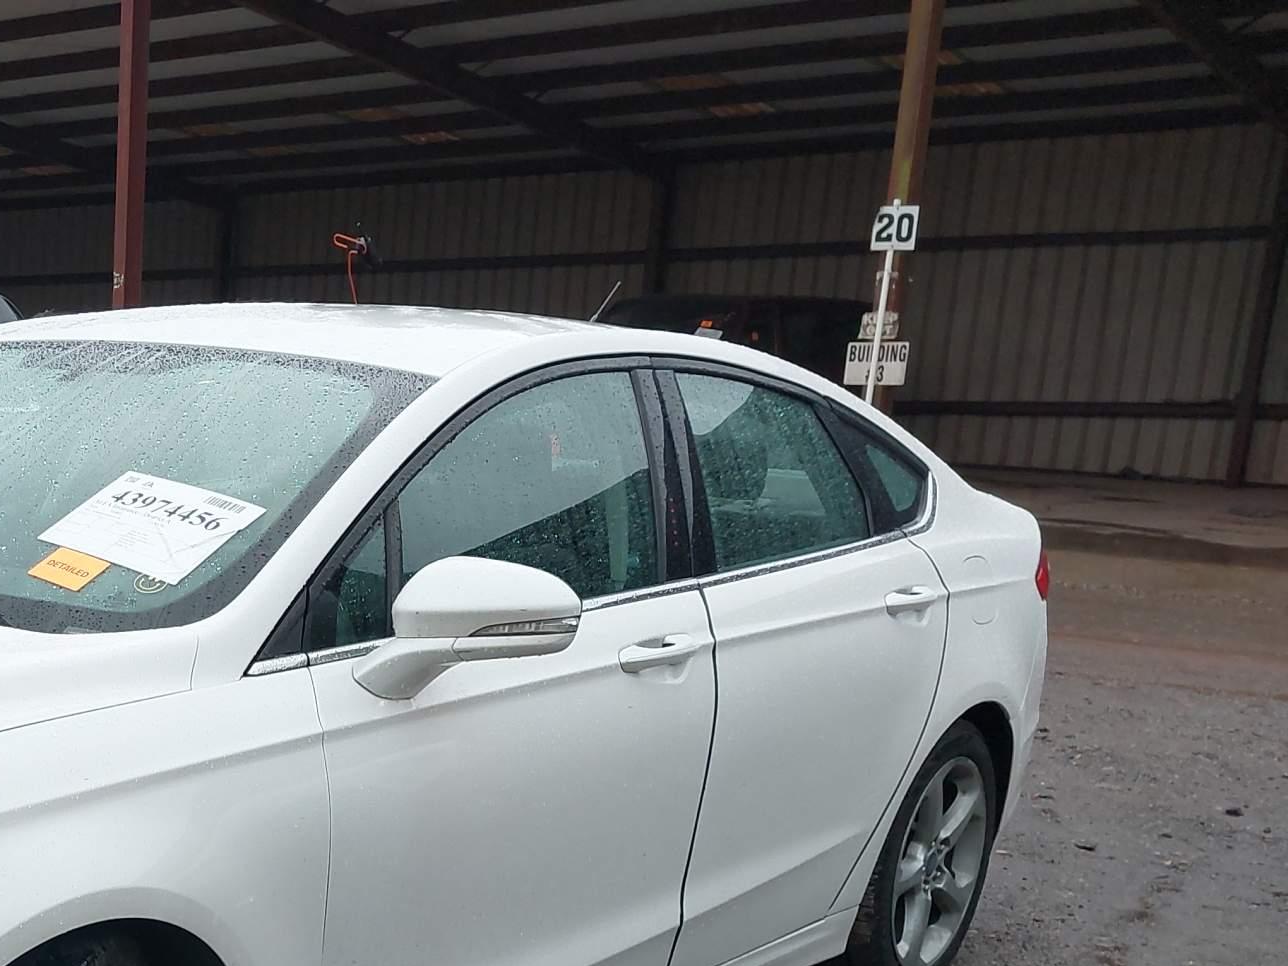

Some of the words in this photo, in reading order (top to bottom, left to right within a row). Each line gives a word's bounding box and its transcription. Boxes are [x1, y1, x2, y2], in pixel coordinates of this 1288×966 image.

[874, 213, 914, 243] 20
[866, 325, 894, 335] OT
[111, 490, 227, 531] 43974456
[46, 559, 90, 579] DETAILED
